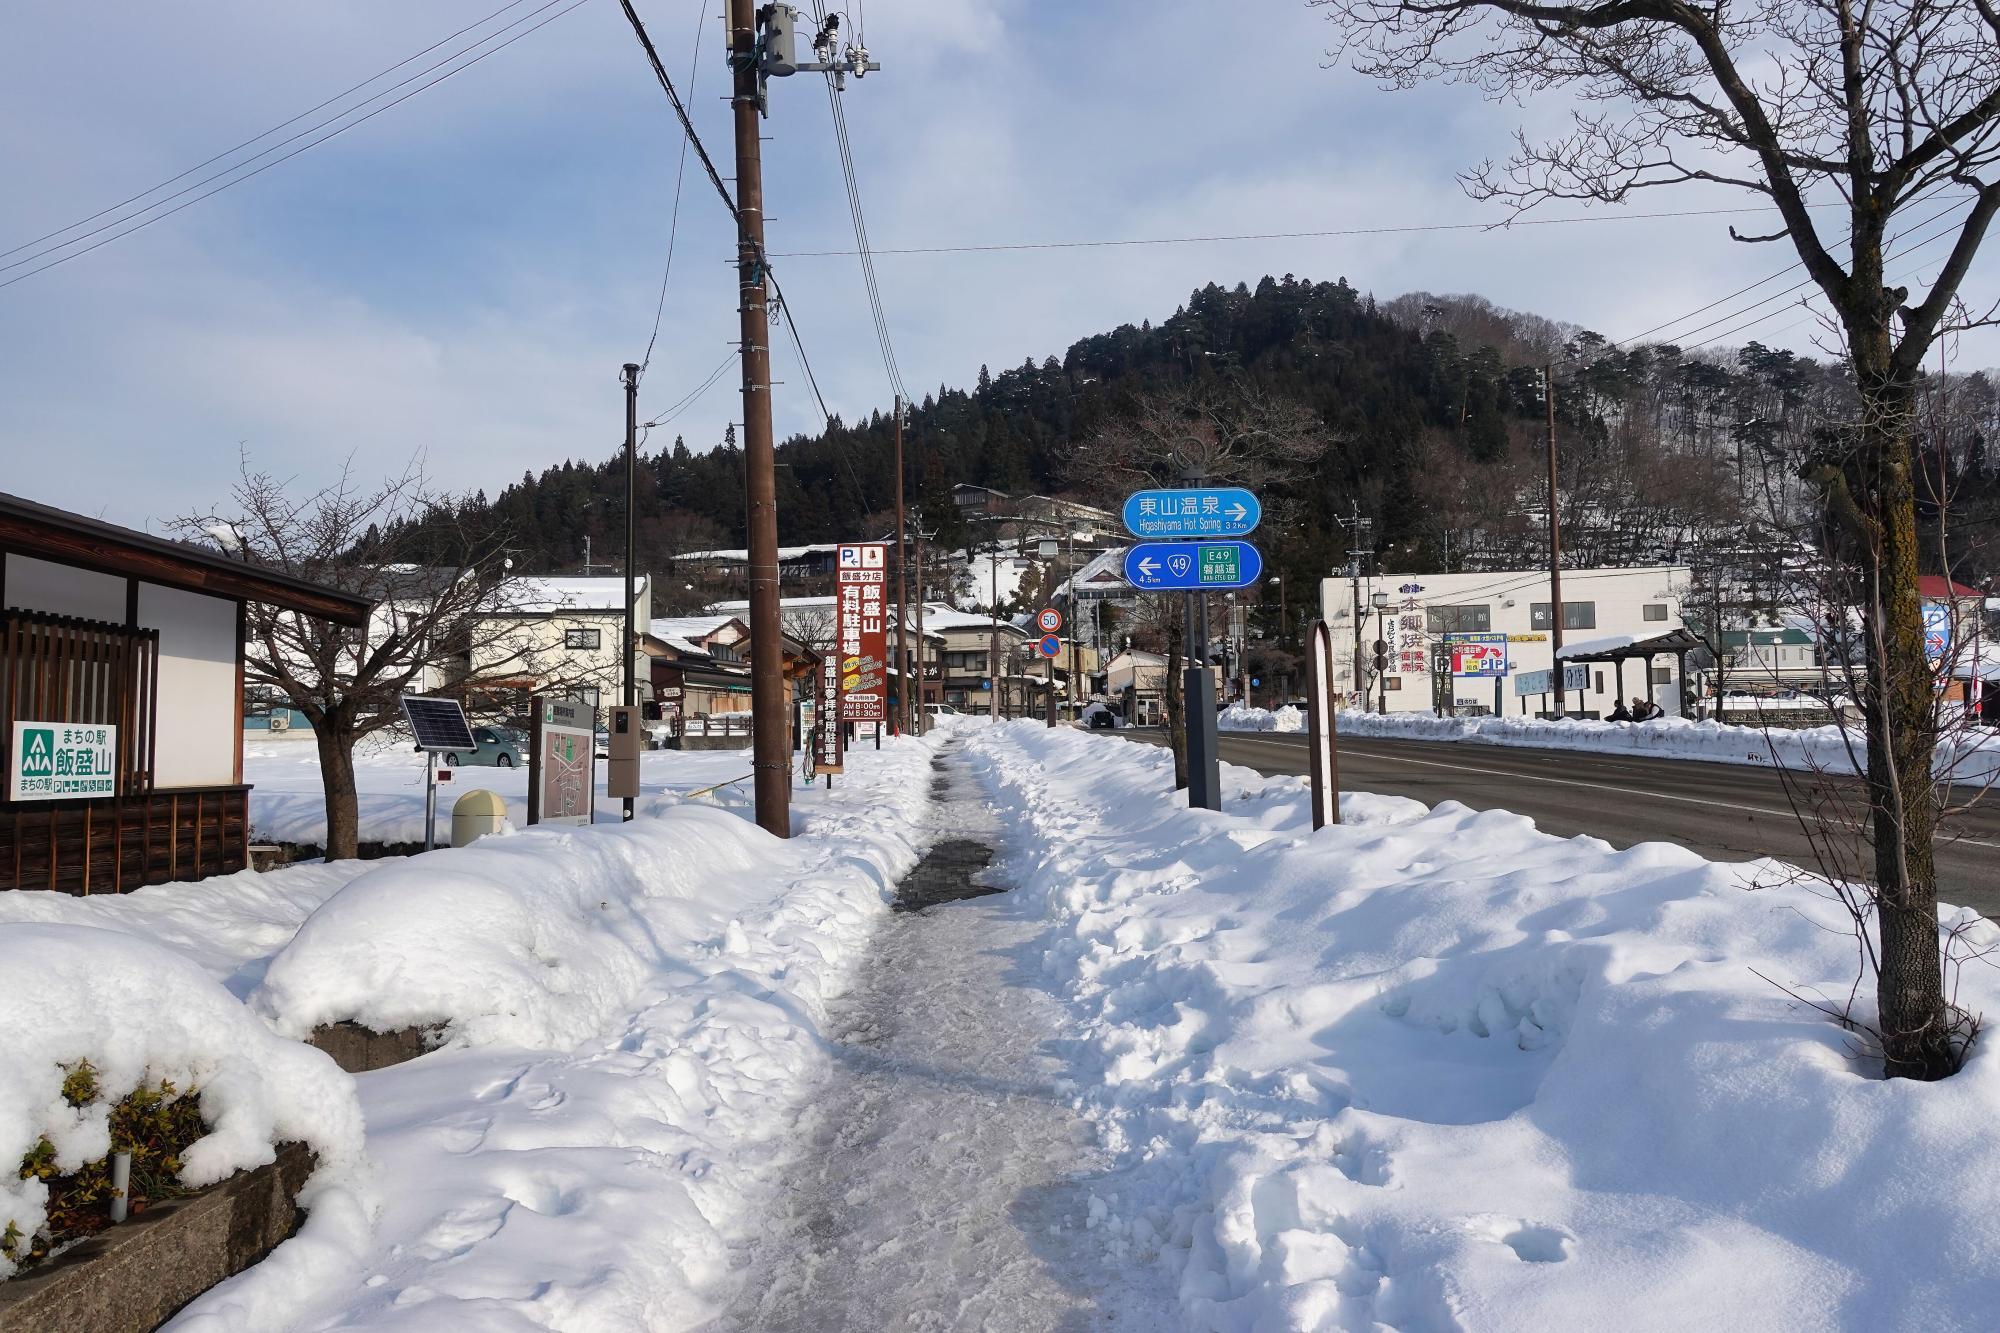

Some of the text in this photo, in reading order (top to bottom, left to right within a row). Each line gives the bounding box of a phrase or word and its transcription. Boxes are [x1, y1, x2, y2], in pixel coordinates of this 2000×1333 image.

[1138, 496, 1221, 516] 東山温泉
[1139, 517, 1221, 533] Higashiyama Hot Spring
[842, 549, 854, 562] P
[1209, 551, 1230, 561] E49
[1172, 558, 1186, 570] 49
[1203, 564, 1236, 575] 磐越道
[842, 572, 882, 581] 飯盛分店
[863, 585, 881, 633] 飯盛山
[843, 585, 860, 660] 有料駐車場
[1043, 616, 1056, 626] 50
[1401, 597, 1424, 649] 本郷焼
[1480, 659, 1488, 668] P
[1495, 659, 1503, 669] P
[63, 729, 107, 745] まちの駅
[54, 748, 112, 776] 飯盛山
[20, 778, 53, 791] まちの駅
